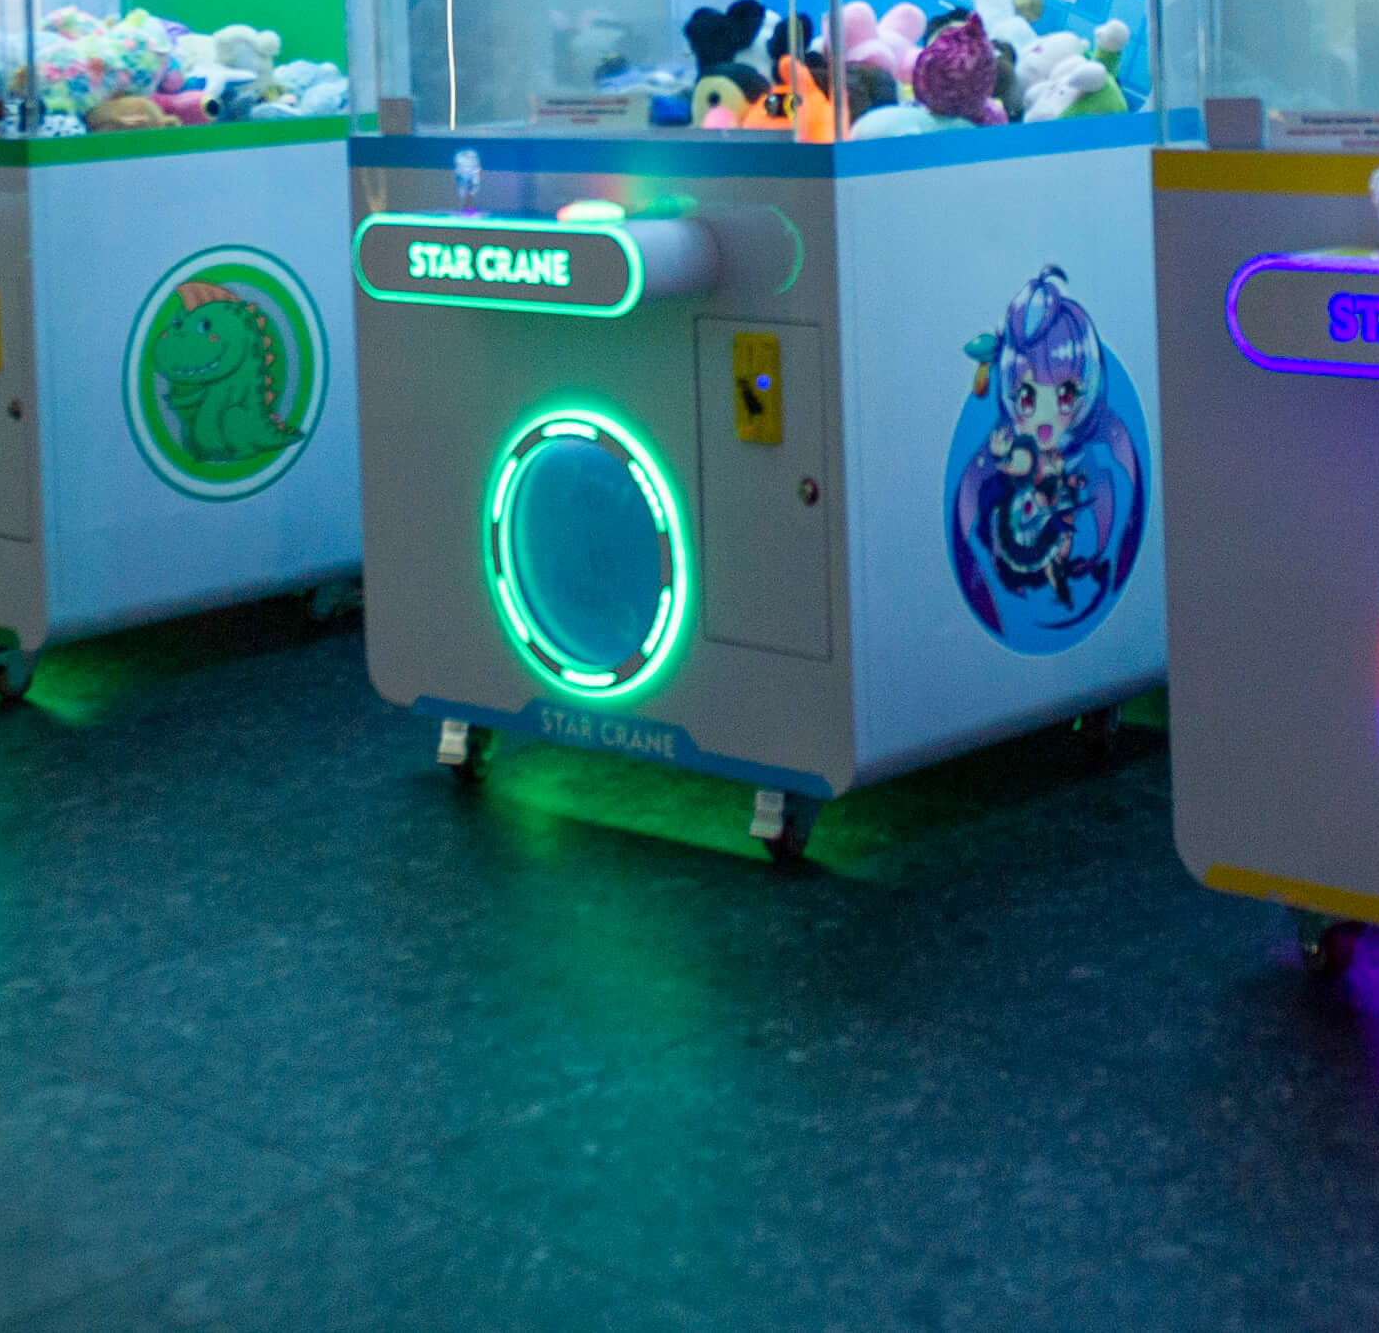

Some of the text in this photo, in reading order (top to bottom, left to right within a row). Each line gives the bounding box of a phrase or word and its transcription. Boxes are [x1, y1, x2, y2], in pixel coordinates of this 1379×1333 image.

[408, 241, 571, 286] STAR CRANE
[541, 707, 676, 758] STAR CRANE
